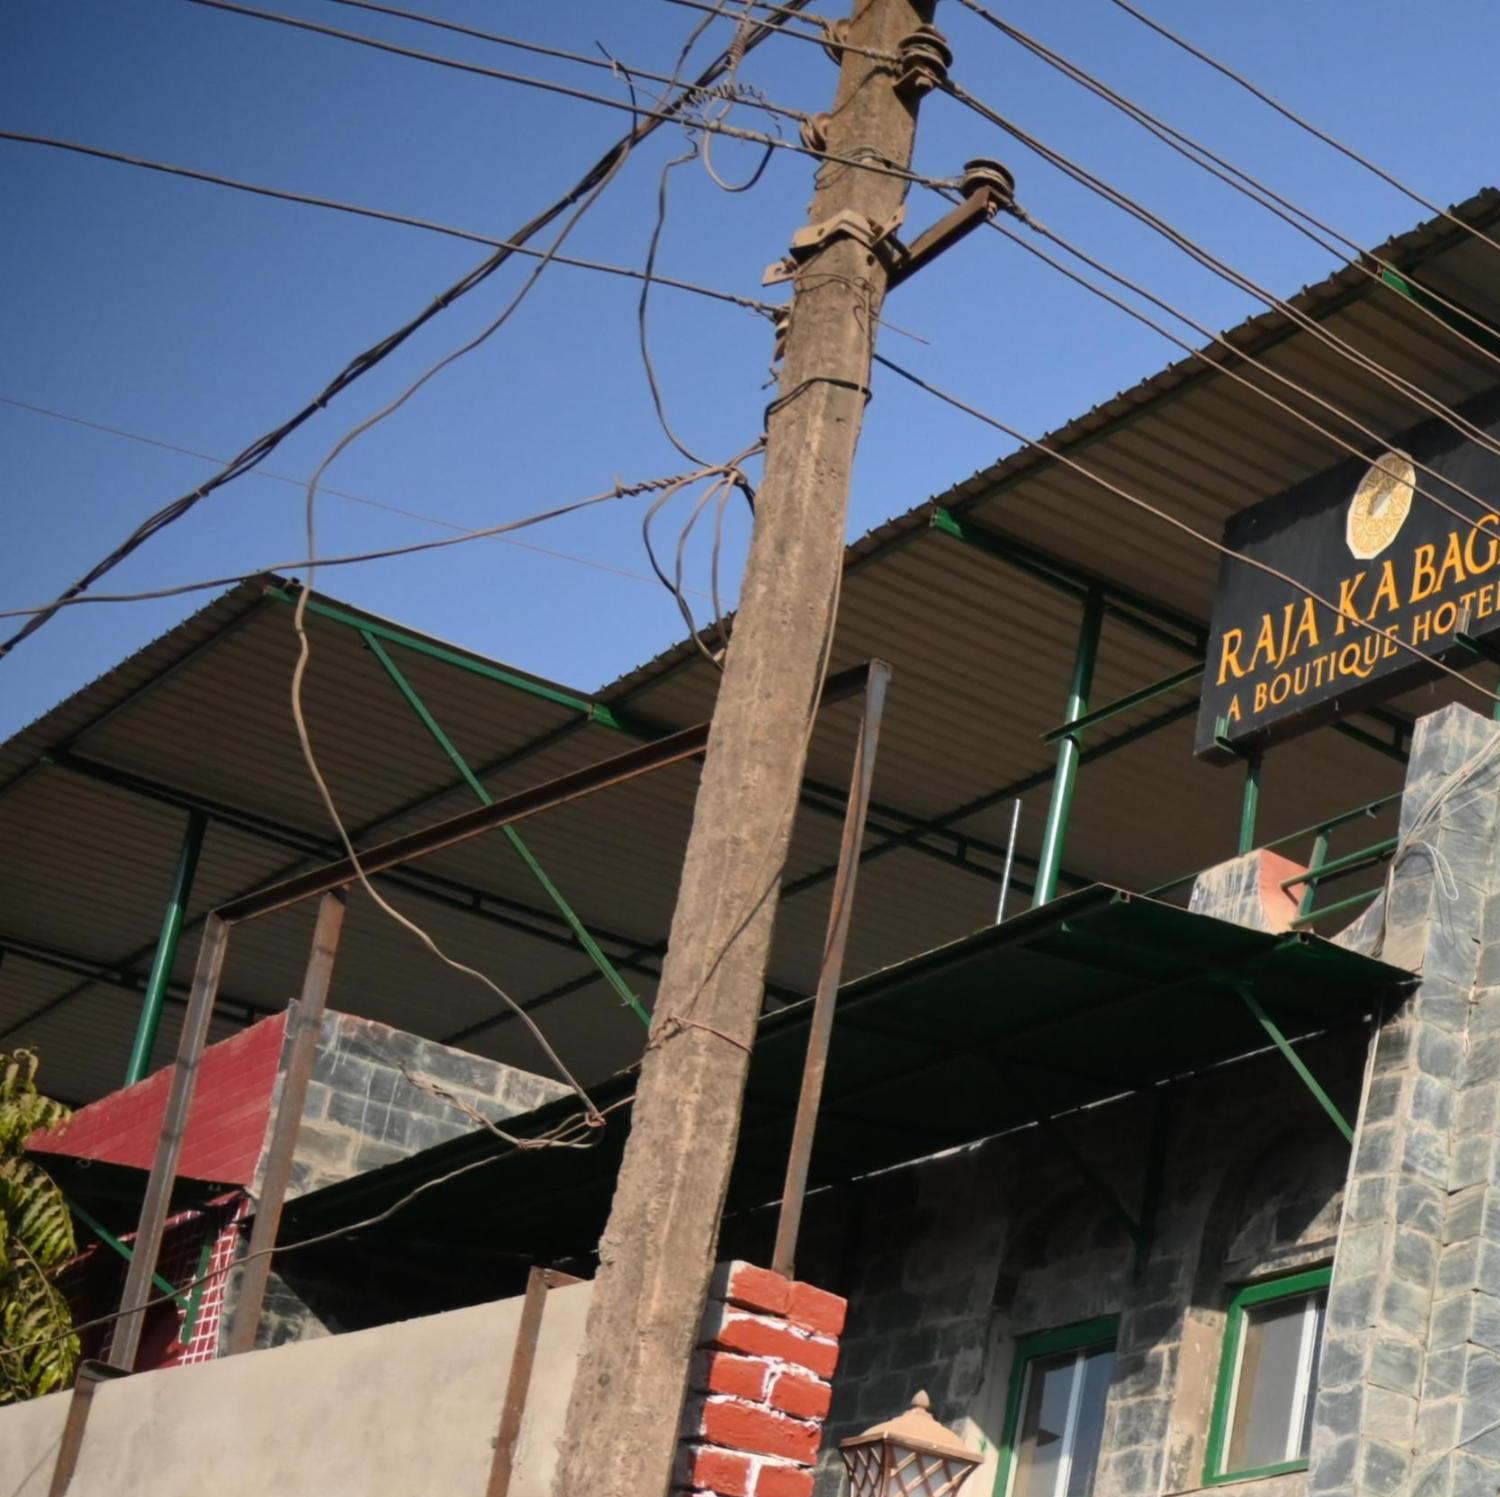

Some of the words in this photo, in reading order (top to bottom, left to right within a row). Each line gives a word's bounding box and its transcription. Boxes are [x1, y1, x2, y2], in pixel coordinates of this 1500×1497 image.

[1216, 597, 1320, 686] RAJA
[1334, 560, 1400, 636] KA
[1226, 694, 1242, 722] A
[1253, 624, 1399, 714] BOUTIQUE
